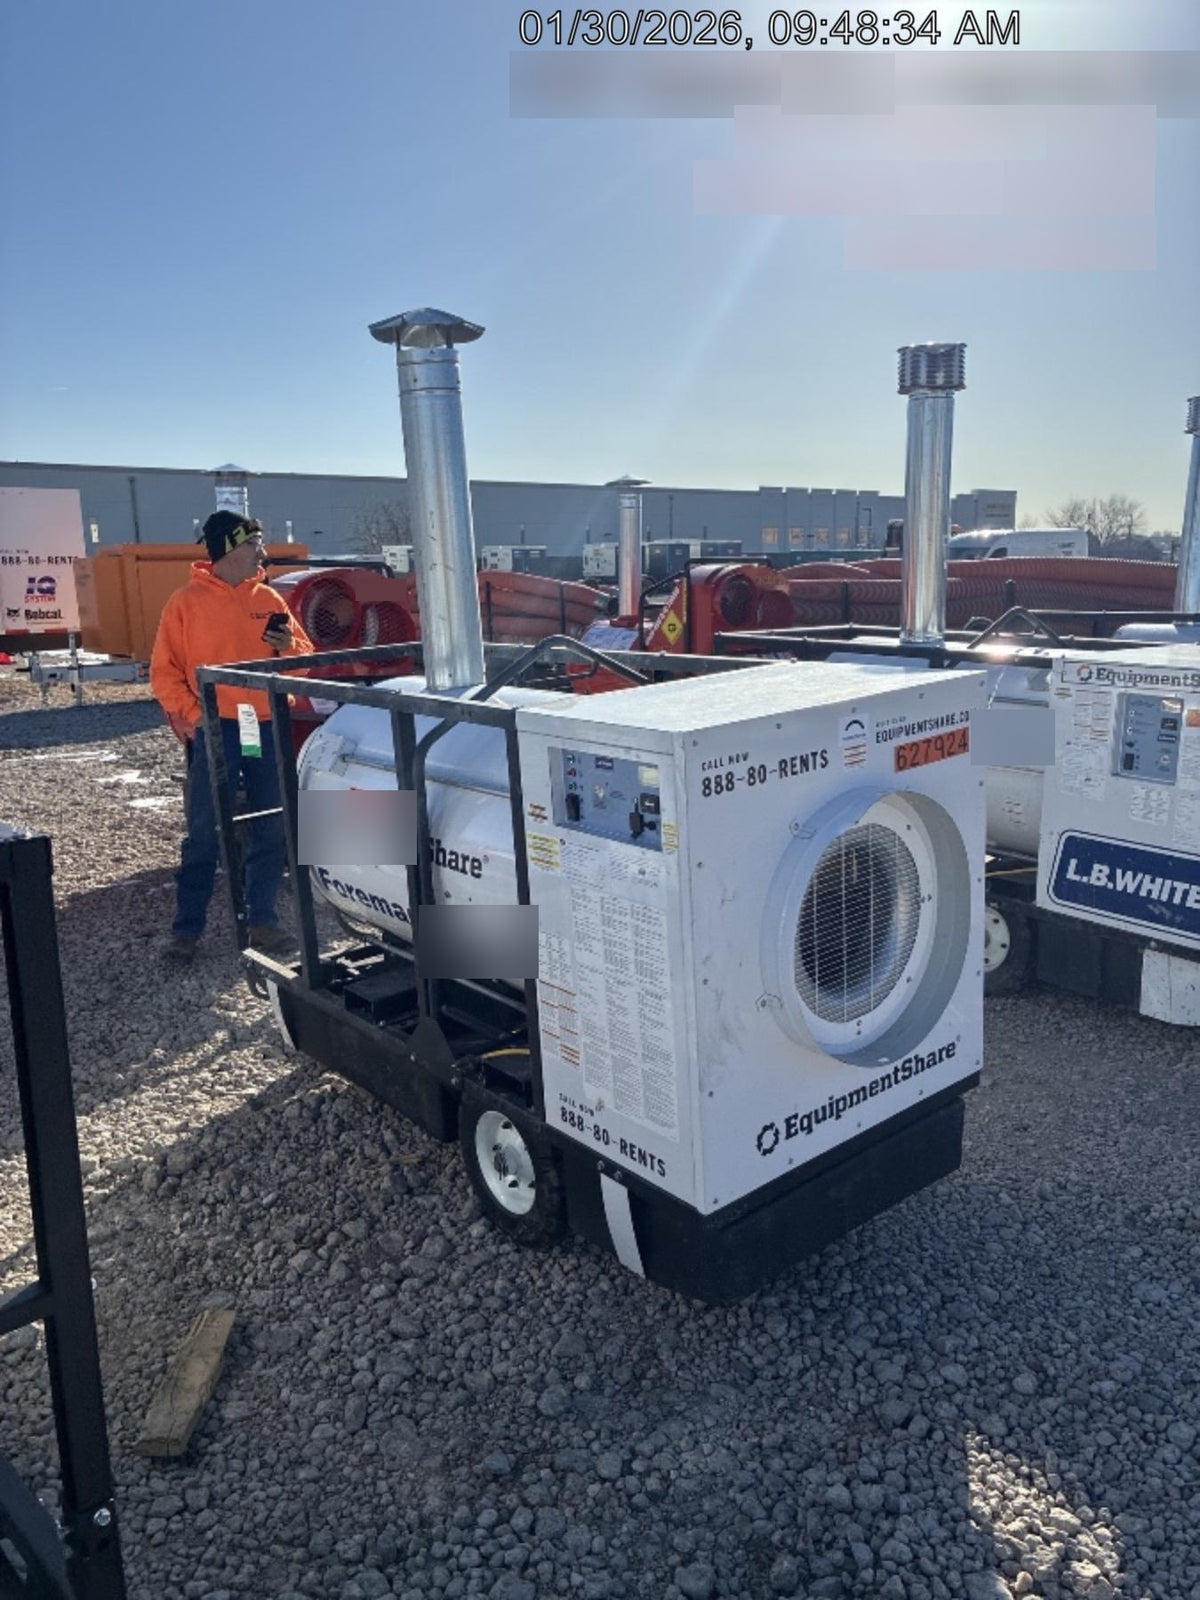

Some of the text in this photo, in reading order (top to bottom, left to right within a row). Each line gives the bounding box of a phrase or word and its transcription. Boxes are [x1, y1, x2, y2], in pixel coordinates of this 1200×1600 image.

[701, 758, 724, 772] CALL
[701, 748, 830, 798] 888-80-RENTS
[895, 727, 969, 771] 627924
[317, 866, 411, 924] Forema
[784, 1040, 956, 1140] EquipmentShare
[560, 1105, 666, 1178] 888-80-RENTS
